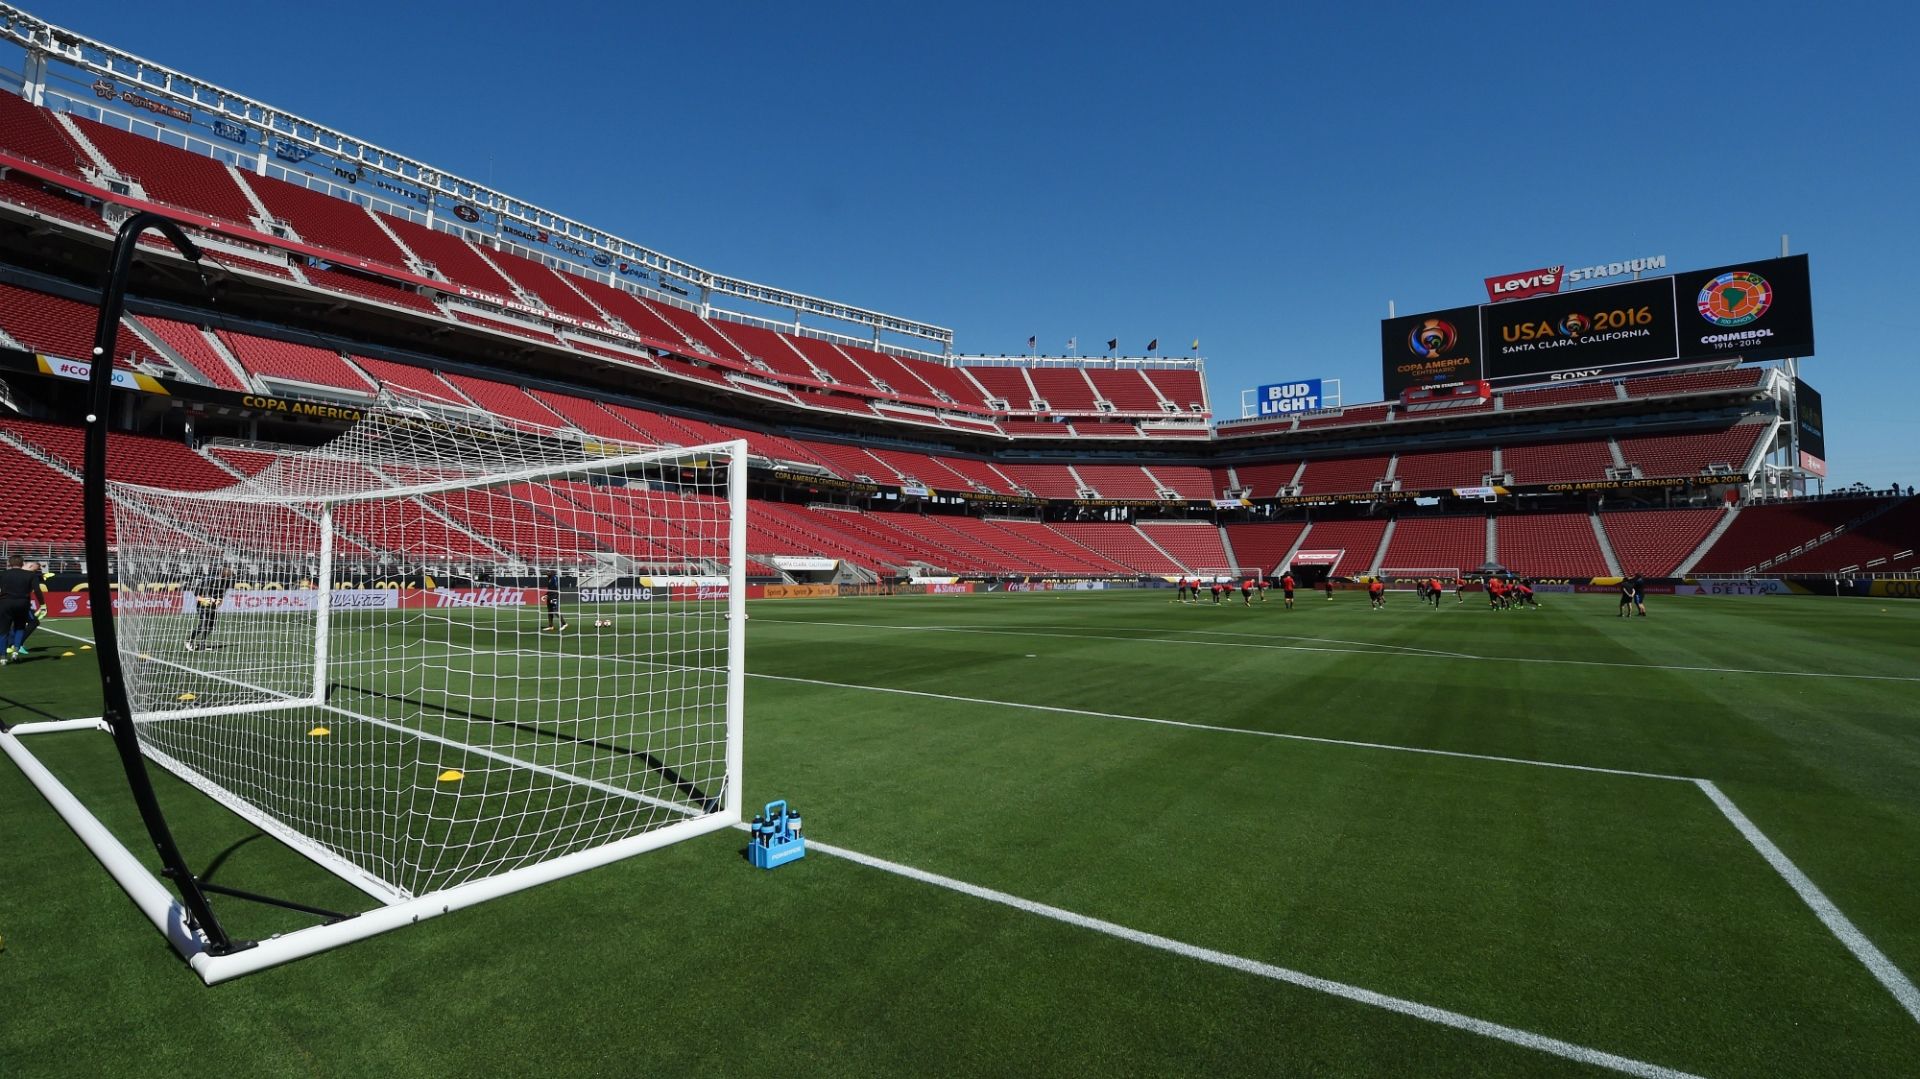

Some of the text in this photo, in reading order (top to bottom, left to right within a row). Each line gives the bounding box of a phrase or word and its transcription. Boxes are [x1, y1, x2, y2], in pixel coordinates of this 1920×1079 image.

[277, 143, 306, 162] SAP
[335, 166, 357, 184] nrg
[377, 180, 417, 200] UNITED
[629, 267, 651, 280] pepsi
[1569, 254, 1667, 283] STADIUM
[506, 301, 546, 318] SUPER
[548, 311, 580, 327] BOWL
[582, 321, 641, 343] CHAMPIONS
[1502, 305, 1653, 343] USA 2016
[1502, 328, 1651, 354] SANTA CLARA, CALIFORNIA
[1701, 328, 1774, 344] CONMEBOL
[1397, 356, 1471, 373] COPA AMERICA
[1550, 369, 1602, 380] SONY
[1268, 383, 1310, 400] BUD
[242, 395, 288, 412] COPA
[292, 403, 361, 422] AMERICA
[1261, 396, 1318, 415] LIGHT
[775, 471, 791, 481] COPA
[792, 473, 818, 484] AMERICA
[1548, 475, 1743, 491] COPA AMERICA CENTENARIO USA 2016
[1300, 495, 1332, 503] AMERICA
[1332, 493, 1379, 502] CENTENARIO
[434, 586, 527, 608] makita
[581, 587, 651, 602] SAMSUNG
[1712, 586, 1767, 595] DELTA
[231, 593, 388, 608] TOTAL UARTZ
